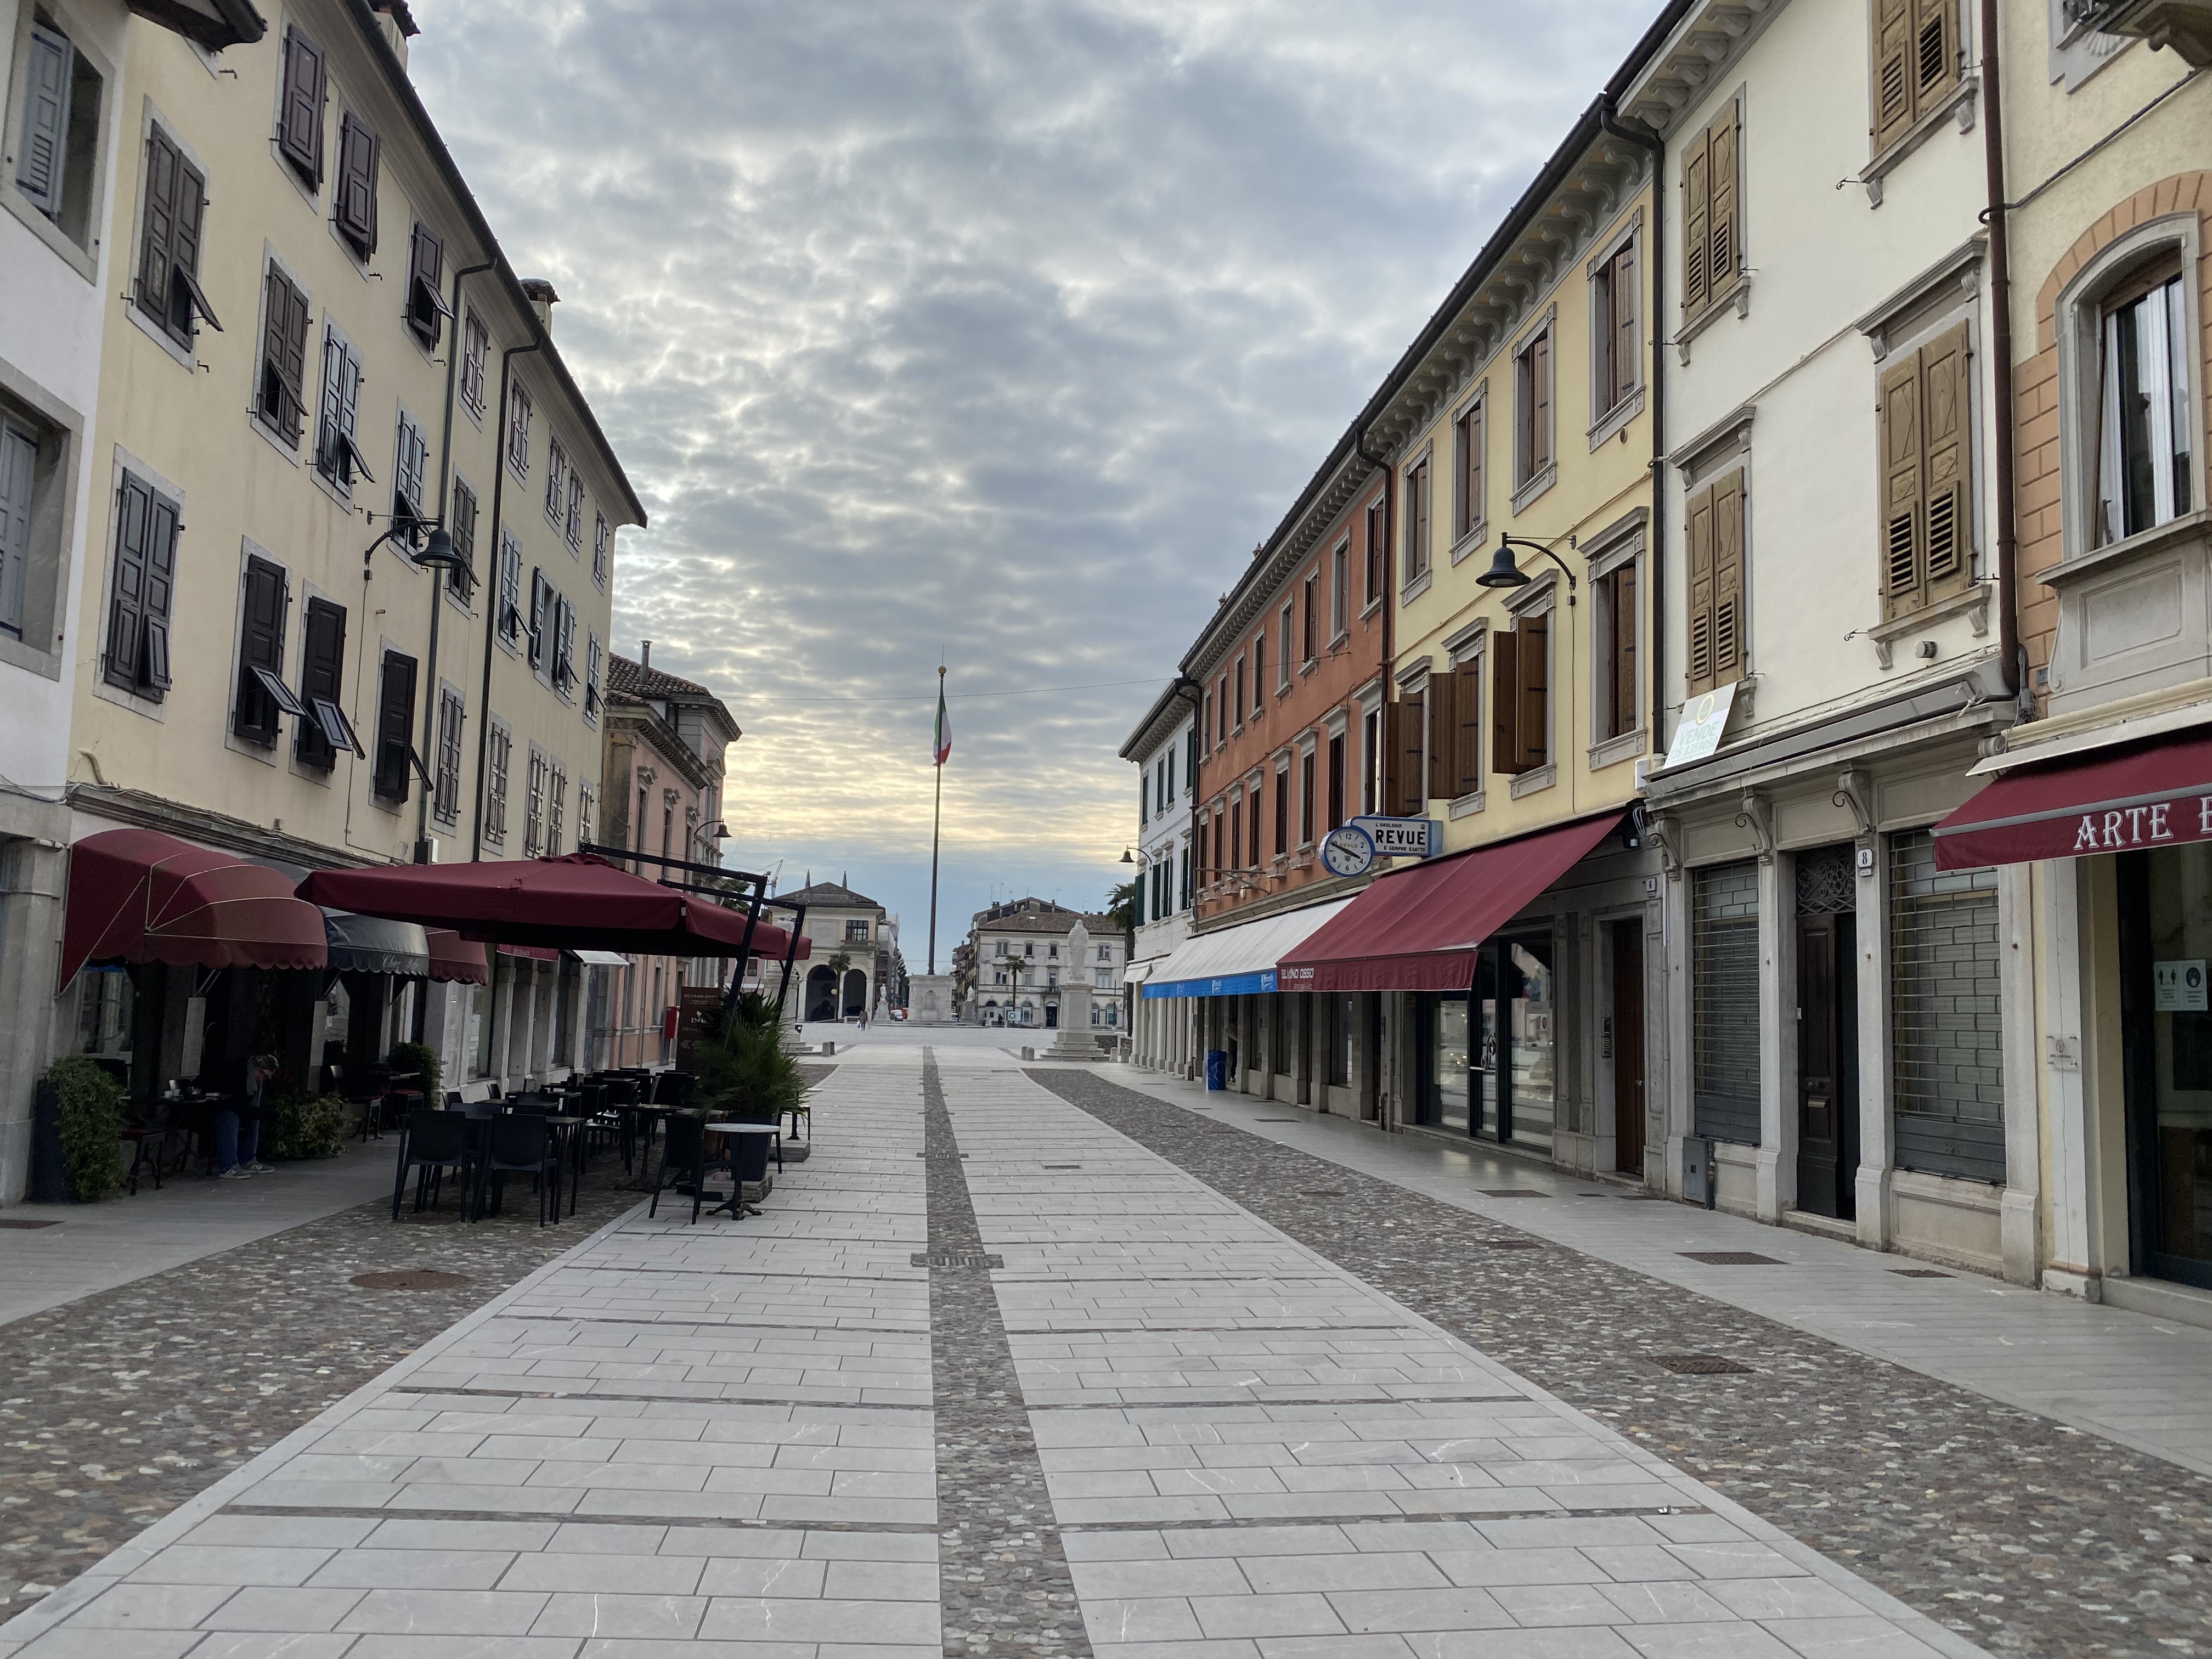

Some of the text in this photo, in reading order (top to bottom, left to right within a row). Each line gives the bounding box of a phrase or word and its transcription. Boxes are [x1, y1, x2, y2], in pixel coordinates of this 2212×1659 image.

[1680, 721, 1719, 746] VENDE
[2074, 803, 2174, 850] ARTE
[1375, 830, 1426, 845] REVUE
[1862, 851, 1867, 865] 8
[1649, 880, 1652, 889] 6
[1300, 968, 1314, 979] OSSO
